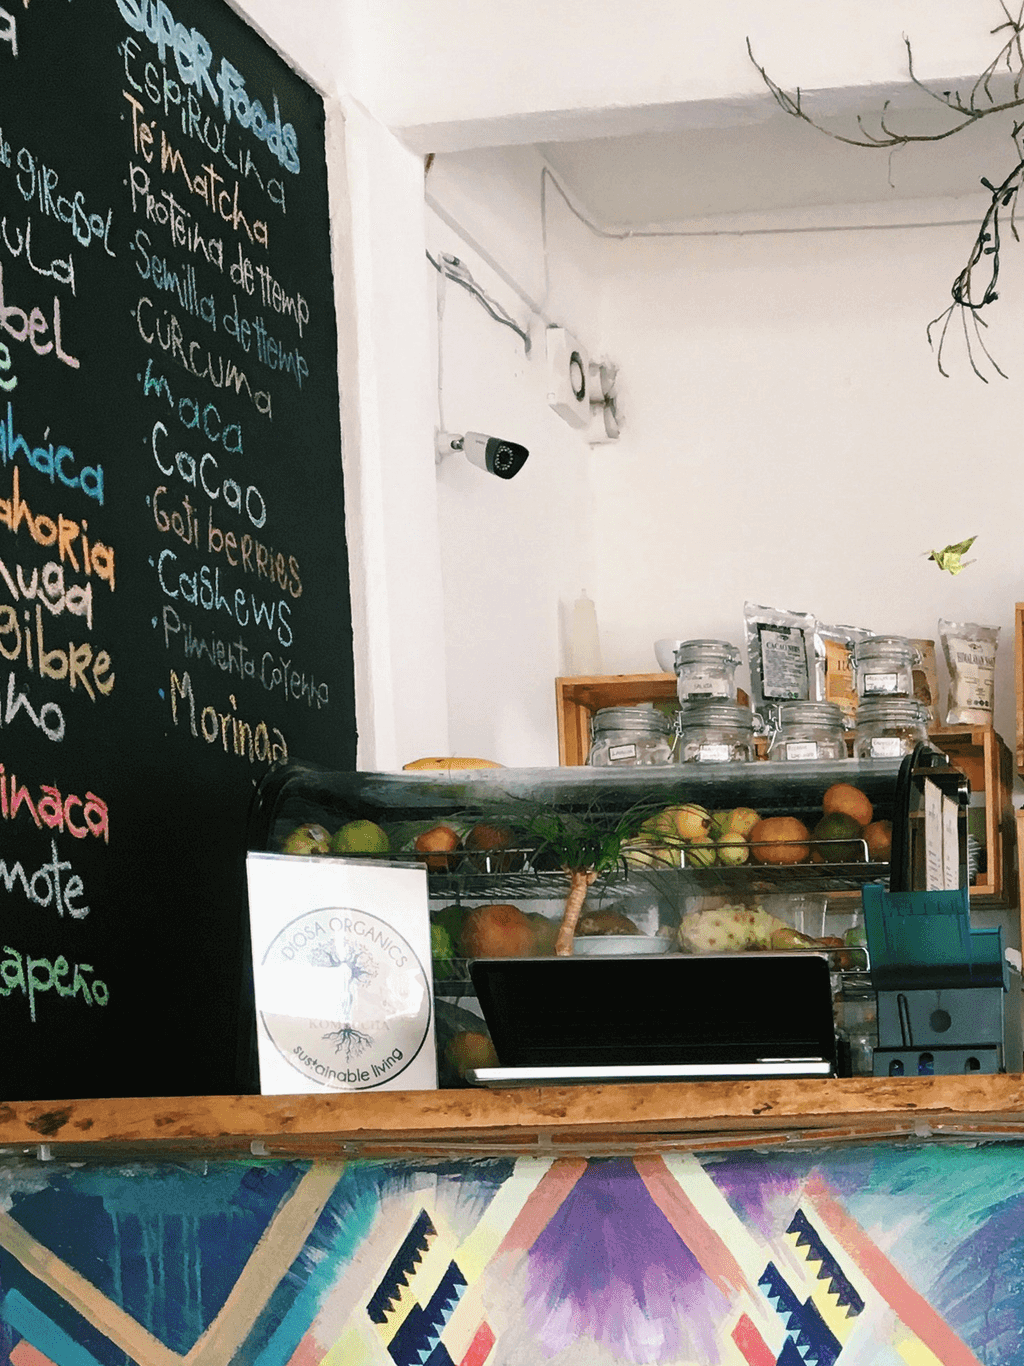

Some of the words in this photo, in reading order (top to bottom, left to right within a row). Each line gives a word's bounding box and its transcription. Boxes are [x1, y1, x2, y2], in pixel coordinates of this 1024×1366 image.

[158, 549, 293, 648] Cashews
[281, 921, 326, 961] DIOSA
[329, 917, 408, 968] ORGANICS
[293, 1045, 370, 1083] sustainable
[371, 1047, 404, 1078] living
